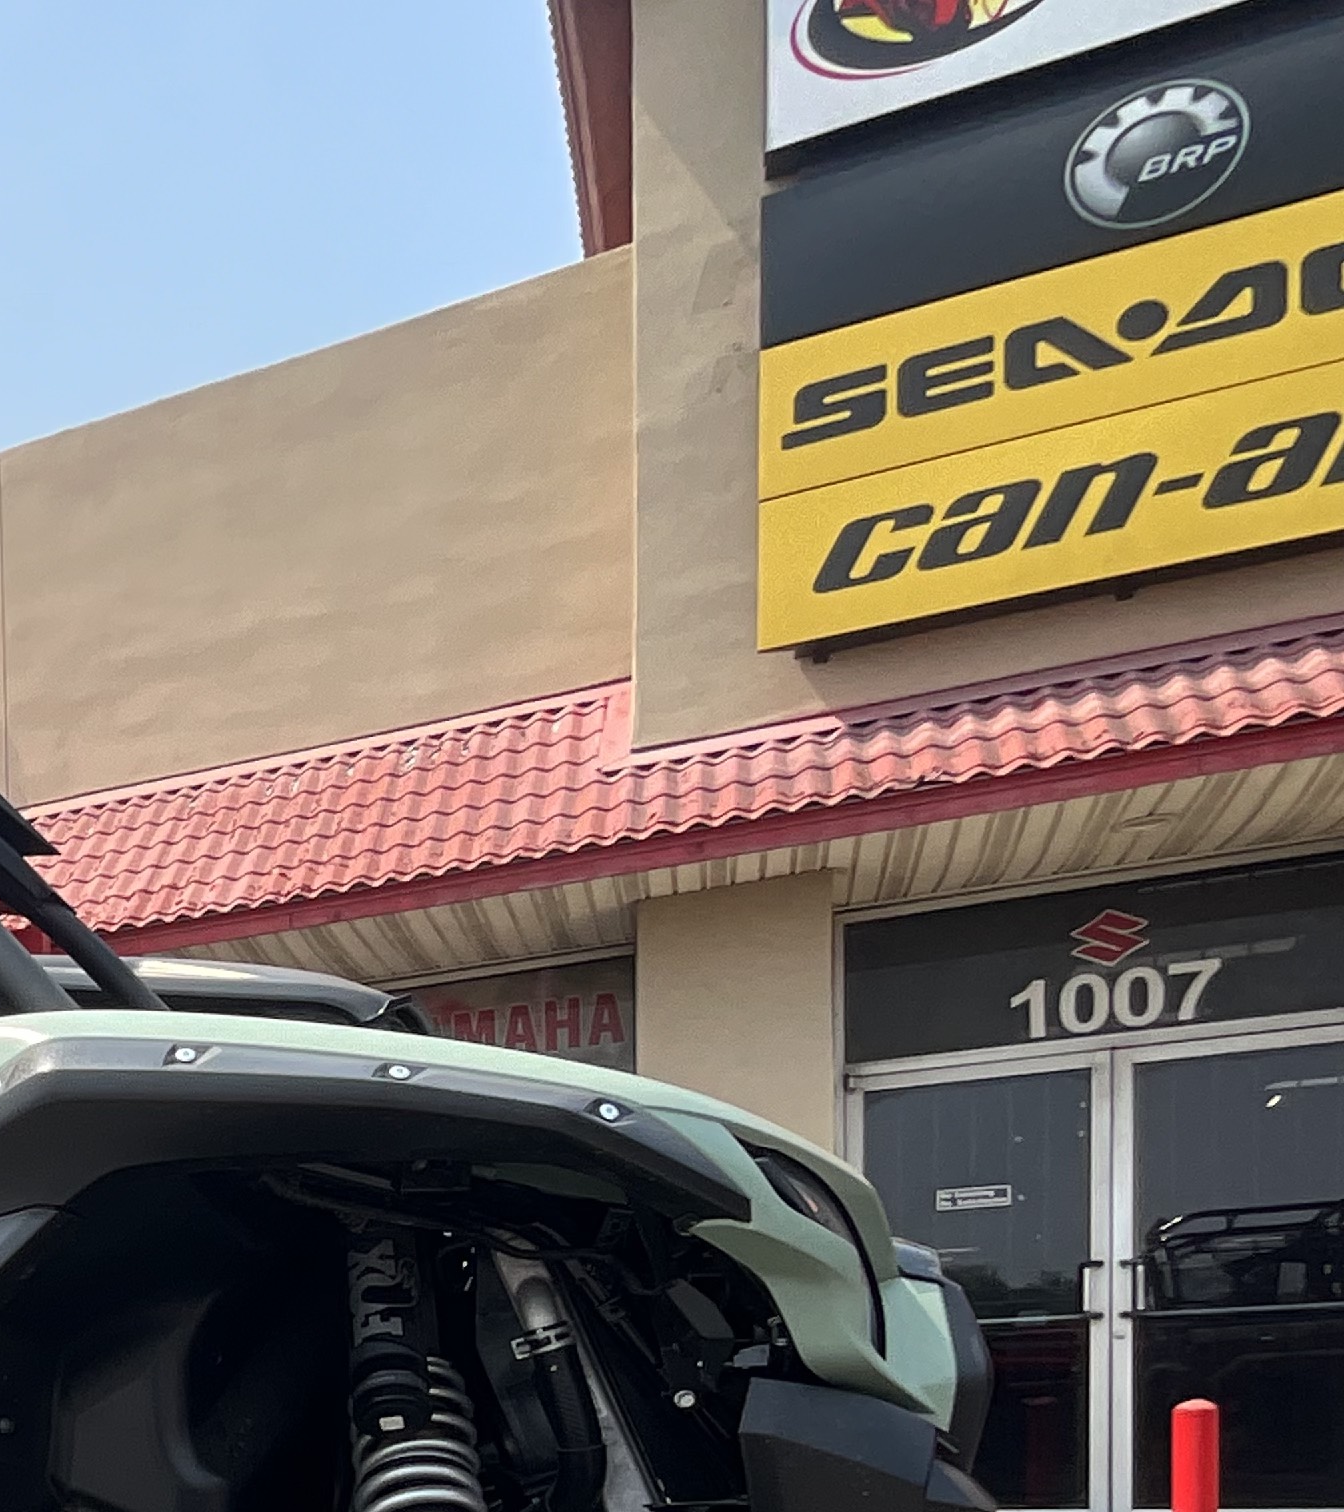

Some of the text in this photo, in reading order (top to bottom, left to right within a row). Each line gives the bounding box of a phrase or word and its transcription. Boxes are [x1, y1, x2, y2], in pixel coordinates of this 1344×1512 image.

[1137, 134, 1237, 183] BRP
[812, 411, 1344, 593] can-a
[1010, 958, 1223, 1038] 1007
